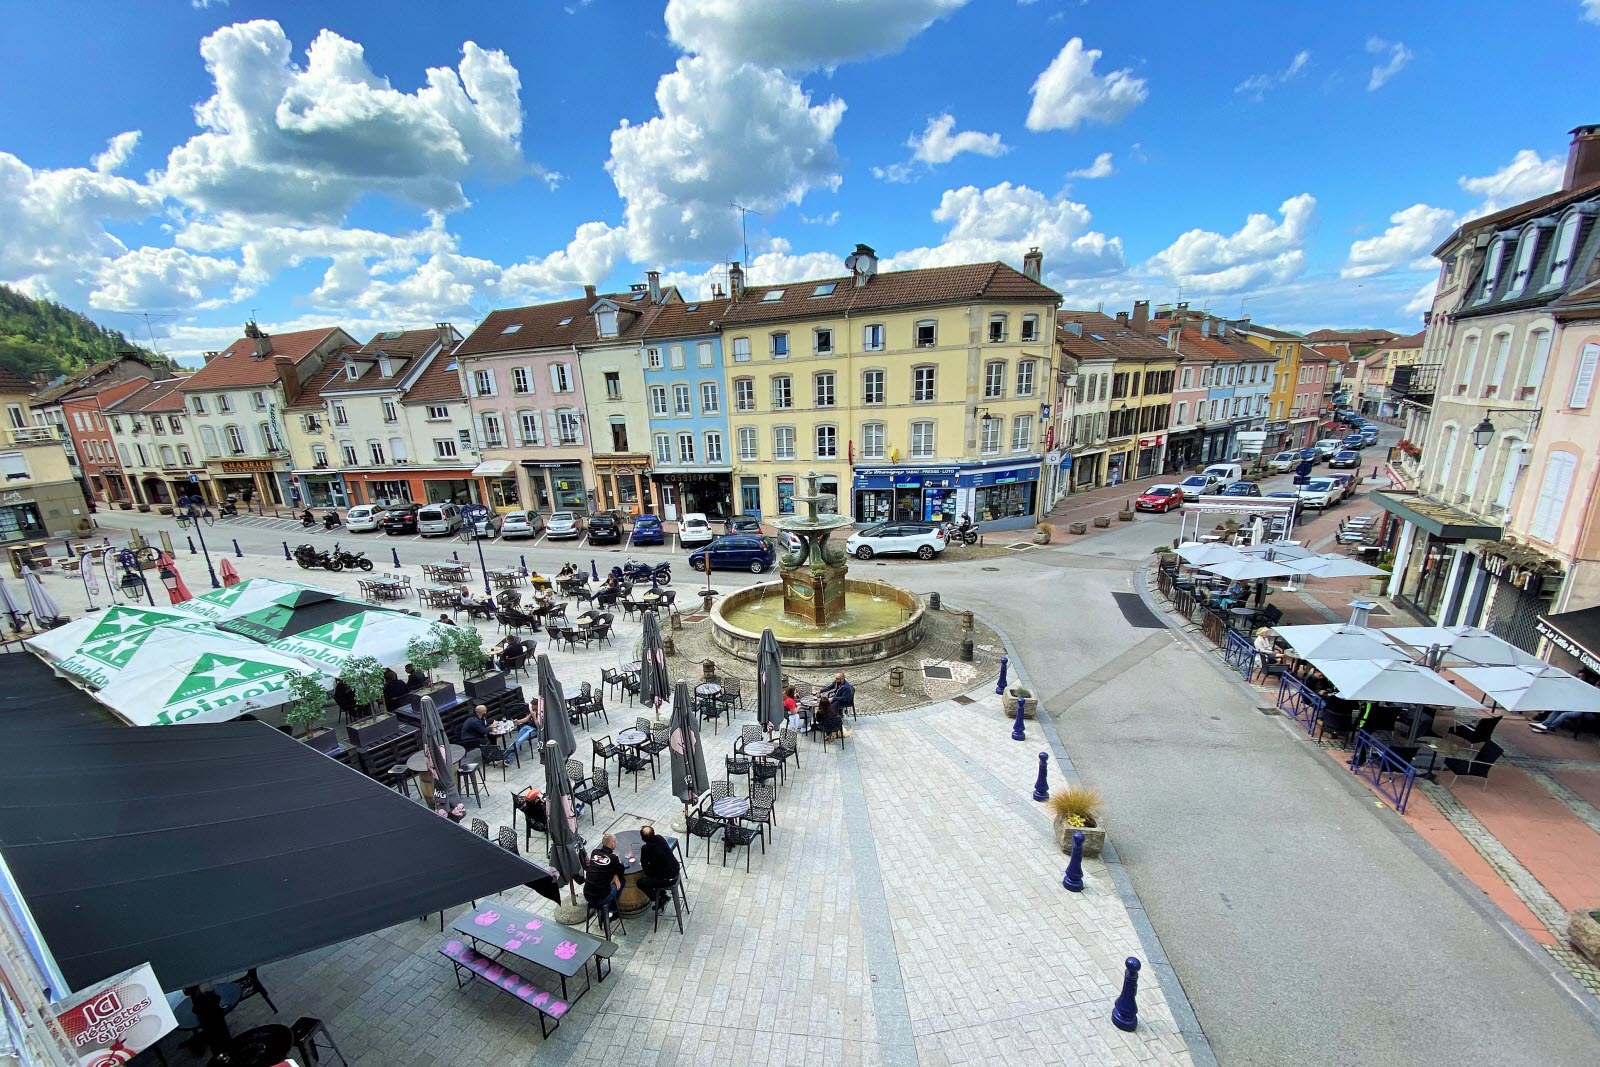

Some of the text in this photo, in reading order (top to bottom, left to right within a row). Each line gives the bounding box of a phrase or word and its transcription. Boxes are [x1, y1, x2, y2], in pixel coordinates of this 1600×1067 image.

[1536, 623, 1548, 633] Bar
[253, 668, 273, 676] MARK
[182, 687, 206, 697] TRADE
[83, 992, 122, 1026] ICI
[75, 998, 152, 1047] Fléchettes
[110, 1015, 140, 1040] jeux
